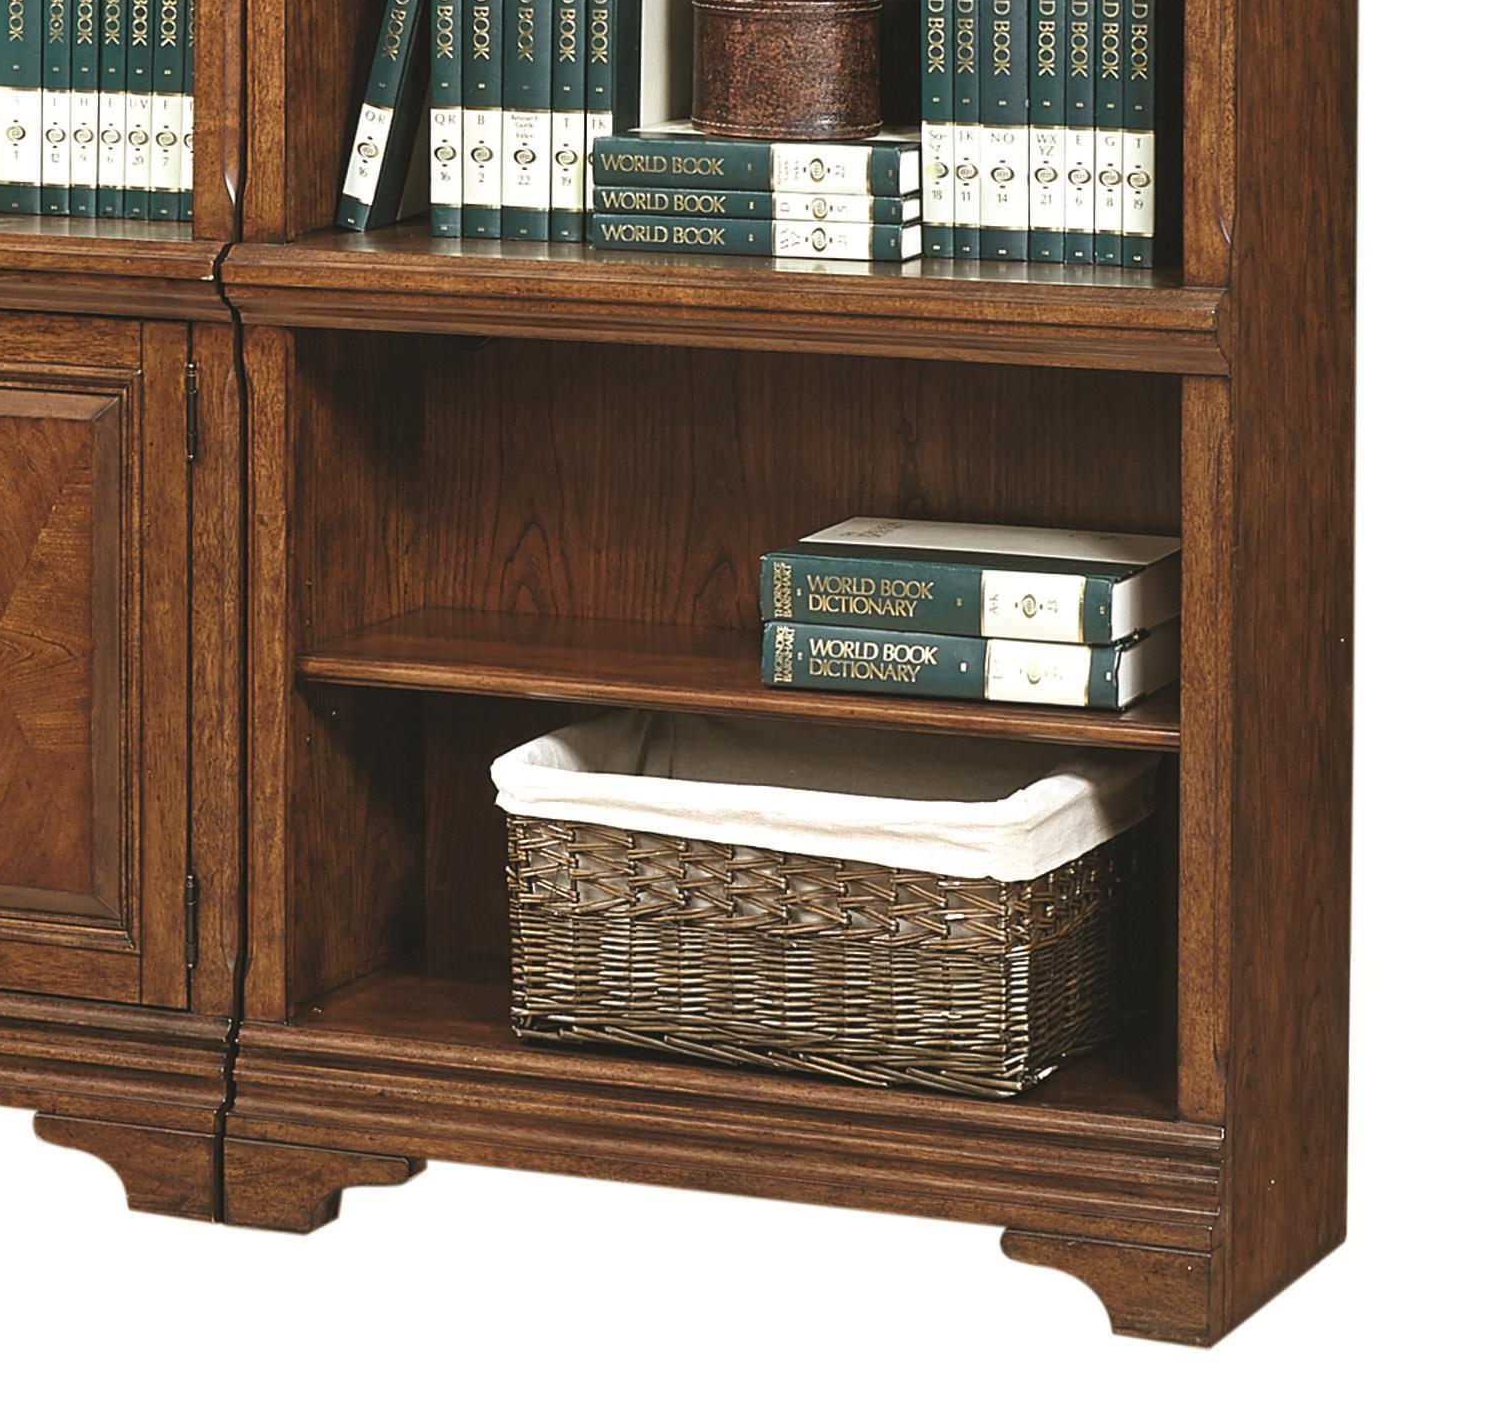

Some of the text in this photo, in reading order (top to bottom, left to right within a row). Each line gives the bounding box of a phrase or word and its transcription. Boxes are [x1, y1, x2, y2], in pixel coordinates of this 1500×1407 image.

[382, 9, 407, 62] BOOK
[437, 5, 454, 59] BOOK
[473, 6, 490, 60] BOOK
[518, 7, 535, 62] BOOK
[560, 8, 577, 63] BOOK
[591, 9, 609, 64] BOOK
[927, 17, 945, 73] BOOK
[957, 18, 974, 74] BOOK
[993, 20, 1011, 76] BOOK
[1038, 21, 1056, 77] BOOK
[1071, 22, 1088, 78] BOOK
[1102, 23, 1120, 79] BOOK
[1131, 24, 1148, 80] BOOK
[563, 117, 570, 129] T
[601, 153, 725, 176] WORLD BOOK
[601, 191, 727, 214] WORLD BOOK
[1040, 194, 1052, 205] 21
[601, 223, 725, 245] WORLD BOOK
[807, 575, 934, 600] WORLD BOOK
[808, 594, 918, 618] DICTIONARY
[809, 638, 939, 666] WORLD BOOK
[809, 658, 921, 683] DICTIONARY
